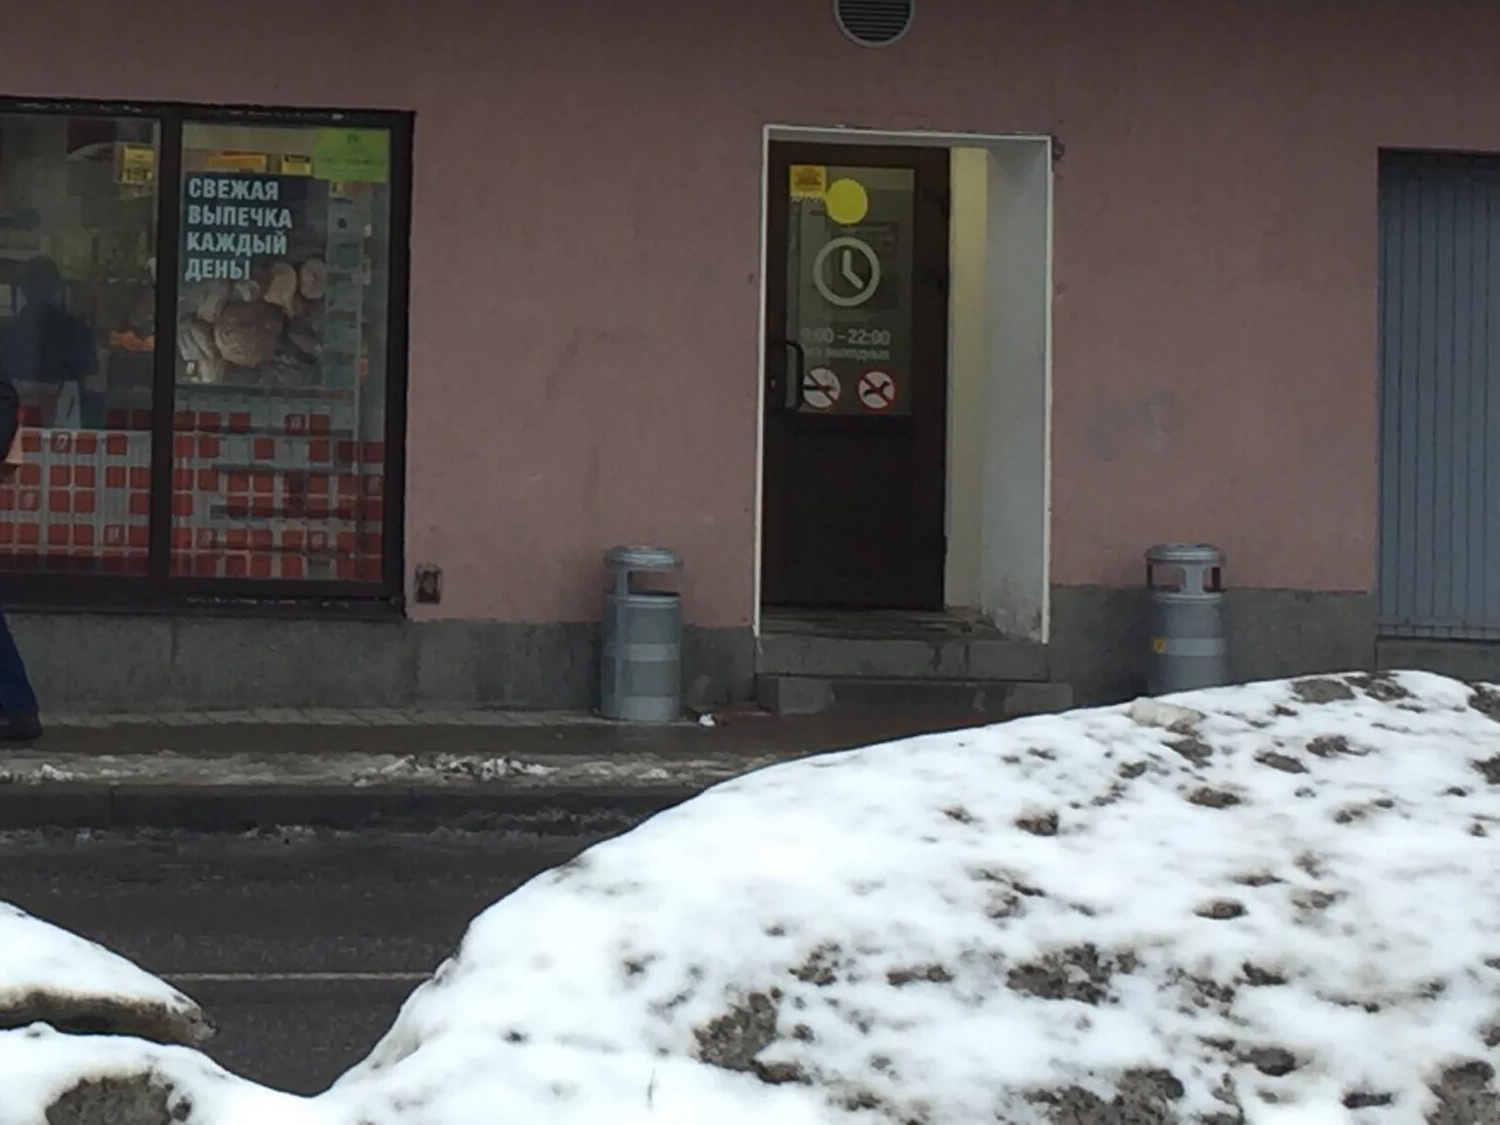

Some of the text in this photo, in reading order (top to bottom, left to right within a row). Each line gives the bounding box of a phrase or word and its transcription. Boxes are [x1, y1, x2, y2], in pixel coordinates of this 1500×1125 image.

[188, 177, 280, 202] СВЕЖАЯ
[187, 204, 293, 229] ВЫПЕЧКА
[186, 229, 288, 257] КАЖДЫЙ
